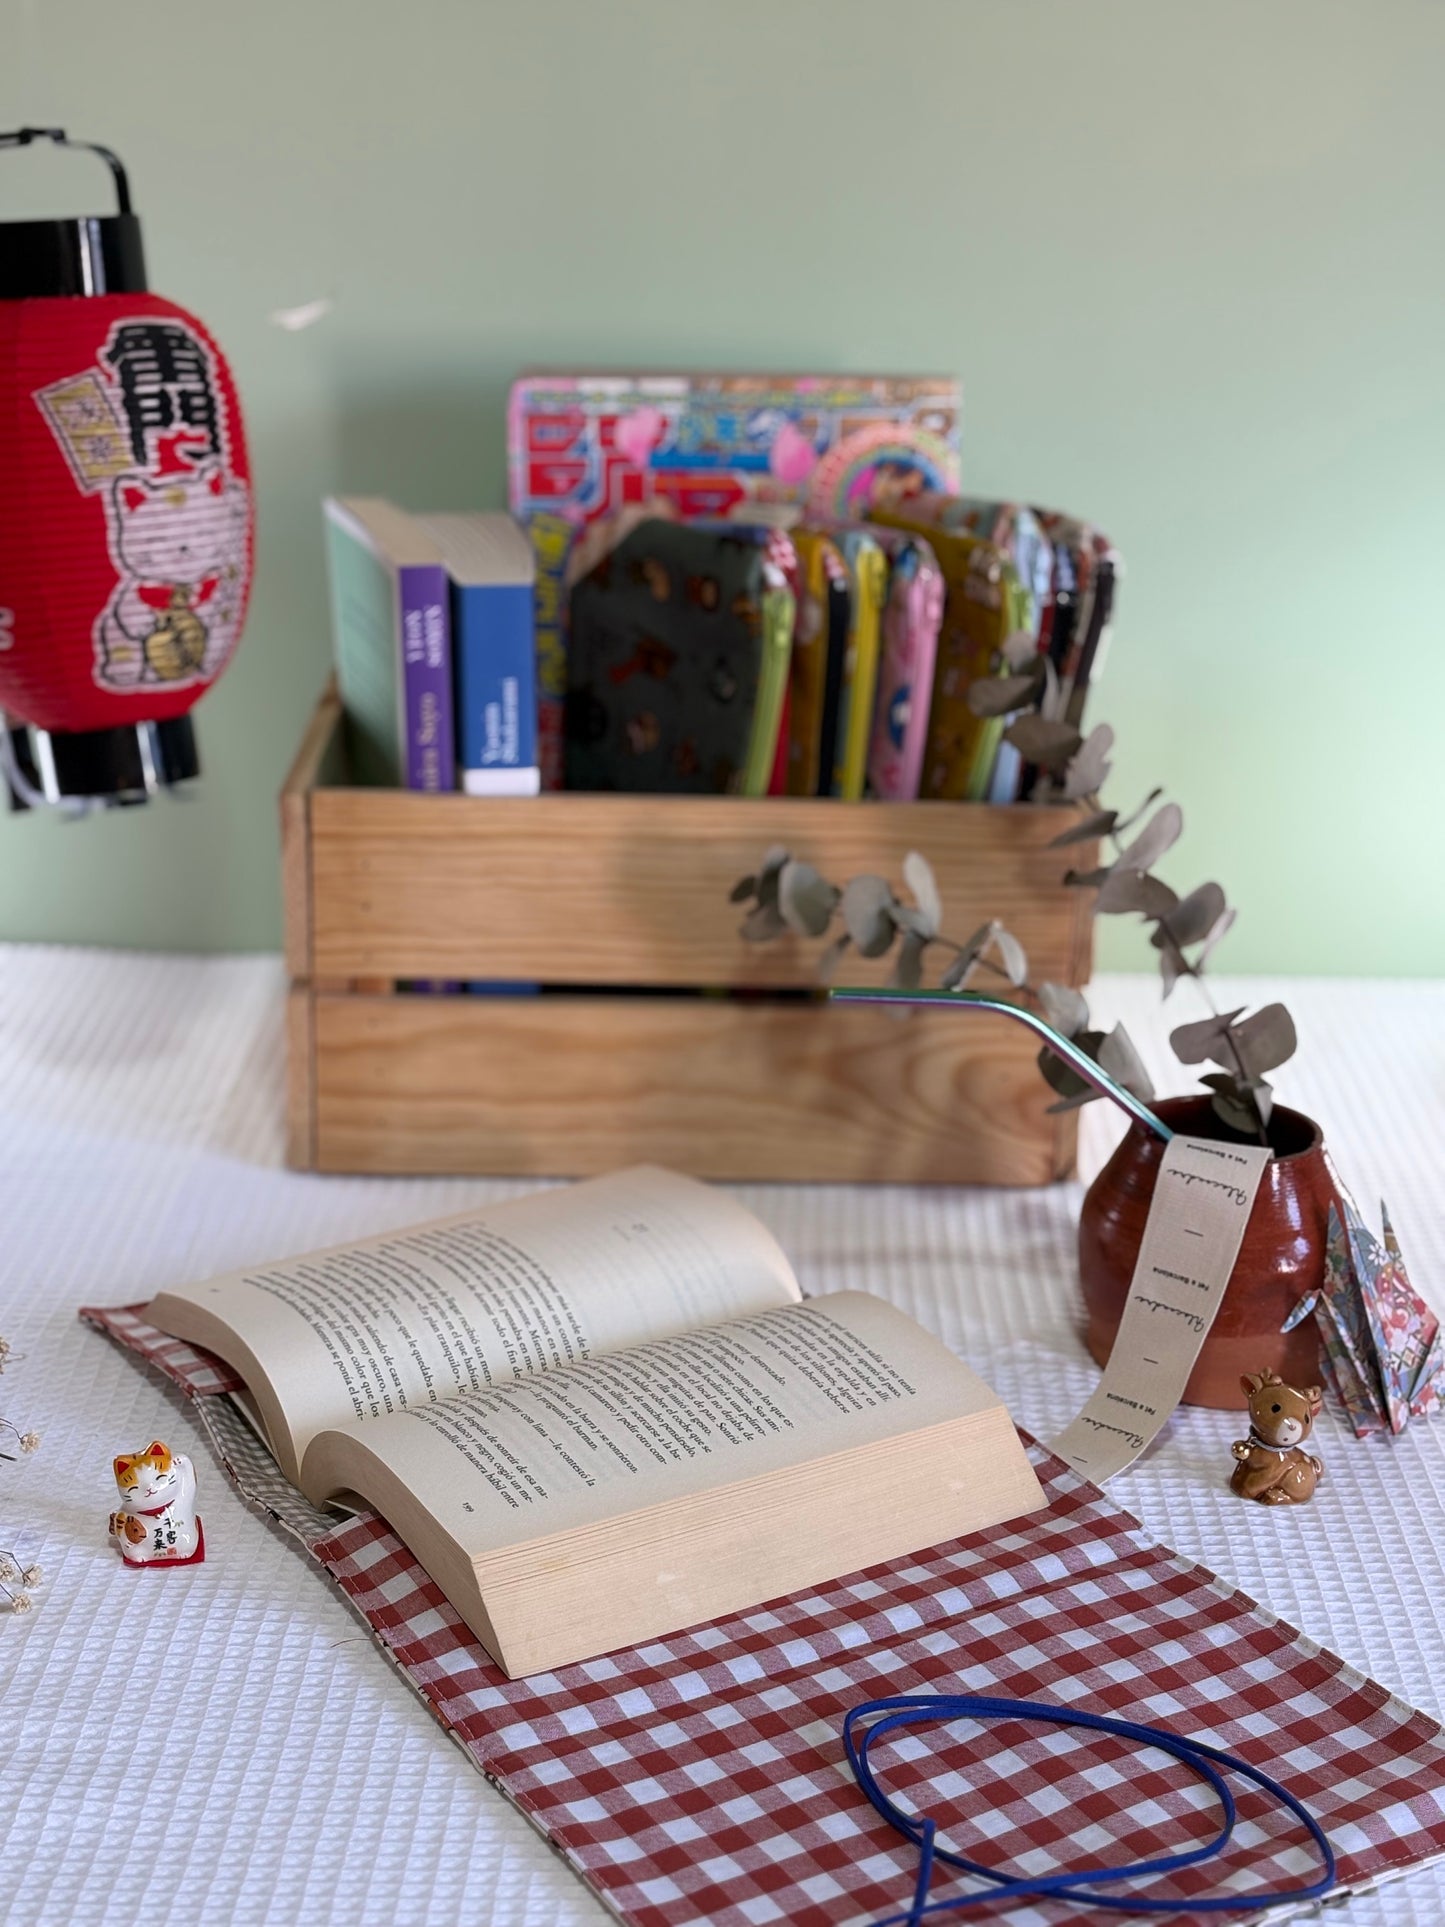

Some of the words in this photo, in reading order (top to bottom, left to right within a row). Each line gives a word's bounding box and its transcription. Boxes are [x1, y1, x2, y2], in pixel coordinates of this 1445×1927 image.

[450, 1330, 463, 1339] el
[491, 1317, 506, 1338] todo
[502, 1339, 514, 1348] el
[551, 1313, 561, 1326] un
[558, 1327, 575, 1364] contra-
[565, 1311, 580, 1334] tarde
[576, 1335, 587, 1348] de
[330, 1351, 340, 1359] se
[454, 1339, 468, 1356] que
[474, 1345, 484, 1359] un
[479, 1359, 492, 1387] men-
[506, 1349, 518, 1364] fin
[518, 1342, 528, 1354] en
[523, 1354, 534, 1375] me-
[528, 1329, 549, 1372] Mientras
[546, 1337, 556, 1350] en
[552, 1351, 562, 1368] ese
[580, 1348, 590, 1360] lo
[843, 1330, 868, 1350] narices
[865, 1349, 883, 1363] salía
[887, 1369, 899, 1378] no
[897, 1378, 916, 1395] tenía
[334, 1360, 353, 1386] ponía
[347, 1386, 360, 1395] el
[350, 1355, 367, 1379] color
[361, 1381, 374, 1400] que
[369, 1400, 380, 1418] los
[356, 1337, 372, 1356] muy
[367, 1357, 386, 1393] oscuro,
[382, 1393, 394, 1414] una
[382, 1355, 394, 1366] de
[388, 1367, 401, 1387] casa
[397, 1387, 407, 1409] ves-
[407, 1339, 417, 1348] le
[412, 1348, 433, 1388] quedaba
[428, 1389, 437, 1402] en
[457, 1383, 467, 1394] le
[463, 1356, 479, 1390] habían
[511, 1365, 522, 1380] de
[666, 1376, 696, 1400] miguitas
[749, 1354, 786, 1386] destrozado.
[777, 1349, 802, 1366] quizá
[797, 1365, 824, 1389] debería
[821, 1387, 850, 1414] beberse
[789, 1344, 801, 1352] de
[798, 1350, 812, 1361] los
[809, 1360, 837, 1386] sillones,
[836, 1386, 863, 1410] alguien
[816, 1351, 828, 1360] en
[825, 1358, 835, 1366] la
[833, 1366, 860, 1391] espalda
[865, 1397, 877, 1406] en
[826, 1345, 852, 1366] amigos
[849, 1366, 877, 1390] estaban
[874, 1389, 891, 1402] allí.
[856, 1357, 882, 1376] apretó
[881, 1381, 901, 1398] paso.
[351, 1396, 367, 1421] abri-
[629, 1375, 652, 1393] hablar
[647, 1392, 668, 1408] sobre
[671, 1414, 693, 1433] coche
[687, 1432, 705, 1445] que
[701, 1445, 712, 1453] se
[655, 1383, 670, 1393] ella
[666, 1392, 689, 1409] imitó
[683, 1409, 695, 1417] su
[689, 1417, 712, 1436] gesto.
[678, 1371, 690, 1379] en
[694, 1383, 717, 1400] local
[710, 1399, 723, 1409] no
[720, 1409, 745, 1431] dejaba
[742, 1431, 754, 1441] de
[692, 1400, 705, 1408] de
[698, 1408, 717, 1423] pan.
[700, 1373, 730, 1396] localizó
[729, 1400, 744, 1413] una
[739, 1412, 766, 1437] pelirro-
[717, 1372, 735, 1386] siete
[731, 1385, 754, 1406] chicas.
[752, 1405, 766, 1417] Sus
[763, 1417, 782, 1433] ami-
[733, 1371, 754, 1388] como
[751, 1387, 763, 1396] en
[759, 1394, 773, 1406] los
[769, 1406, 785, 1418] que
[782, 1418, 794, 1428] es-
[535, 1396, 572, 1420] preguntó
[572, 1424, 598, 1451] barman.
[564, 1401, 575, 1409] en
[571, 1407, 582, 1415] la
[578, 1412, 597, 1430] barra
[605, 1441, 638, 1474] sonrieron.
[587, 1388, 617, 1413] camarero
[616, 1416, 639, 1433] pedir
[635, 1433, 652, 1448] otro
[649, 1447, 667, 1465] com-
[607, 1390, 628, 1406] sillón
[629, 1410, 661, 1437] acercarse
[661, 1441, 673, 1450] la
[668, 1448, 682, 1461] ba-
[632, 1394, 644, 1402] de
[639, 1401, 664, 1423] mucho
[658, 1422, 696, 1458] pensárselo,
[715, 1421, 742, 1445] Sonrió
[435, 1425, 462, 1444] enrolló
[455, 1443, 468, 1452] de
[462, 1451, 488, 1474] manera
[484, 1472, 507, 1491] hábil
[500, 1490, 519, 1508] entre
[450, 1420, 473, 1439] blanco
[474, 1442, 495, 1463] negro,
[493, 1461, 516, 1480] cogió
[509, 1479, 522, 1490] un
[518, 1489, 533, 1503] me-
[463, 1415, 490, 1436] después
[485, 1435, 498, 1443] de
[493, 1442, 520, 1465] sonreír
[515, 1465, 528, 1474] de
[523, 1474, 537, 1485] esa
[533, 1485, 548, 1499] ma-
[520, 1413, 535, 1424] con
[531, 1422, 548, 1437] lima
[559, 1450, 591, 1479] contestó
[585, 1478, 596, 1487] la
[462, 1501, 474, 1512] 199
